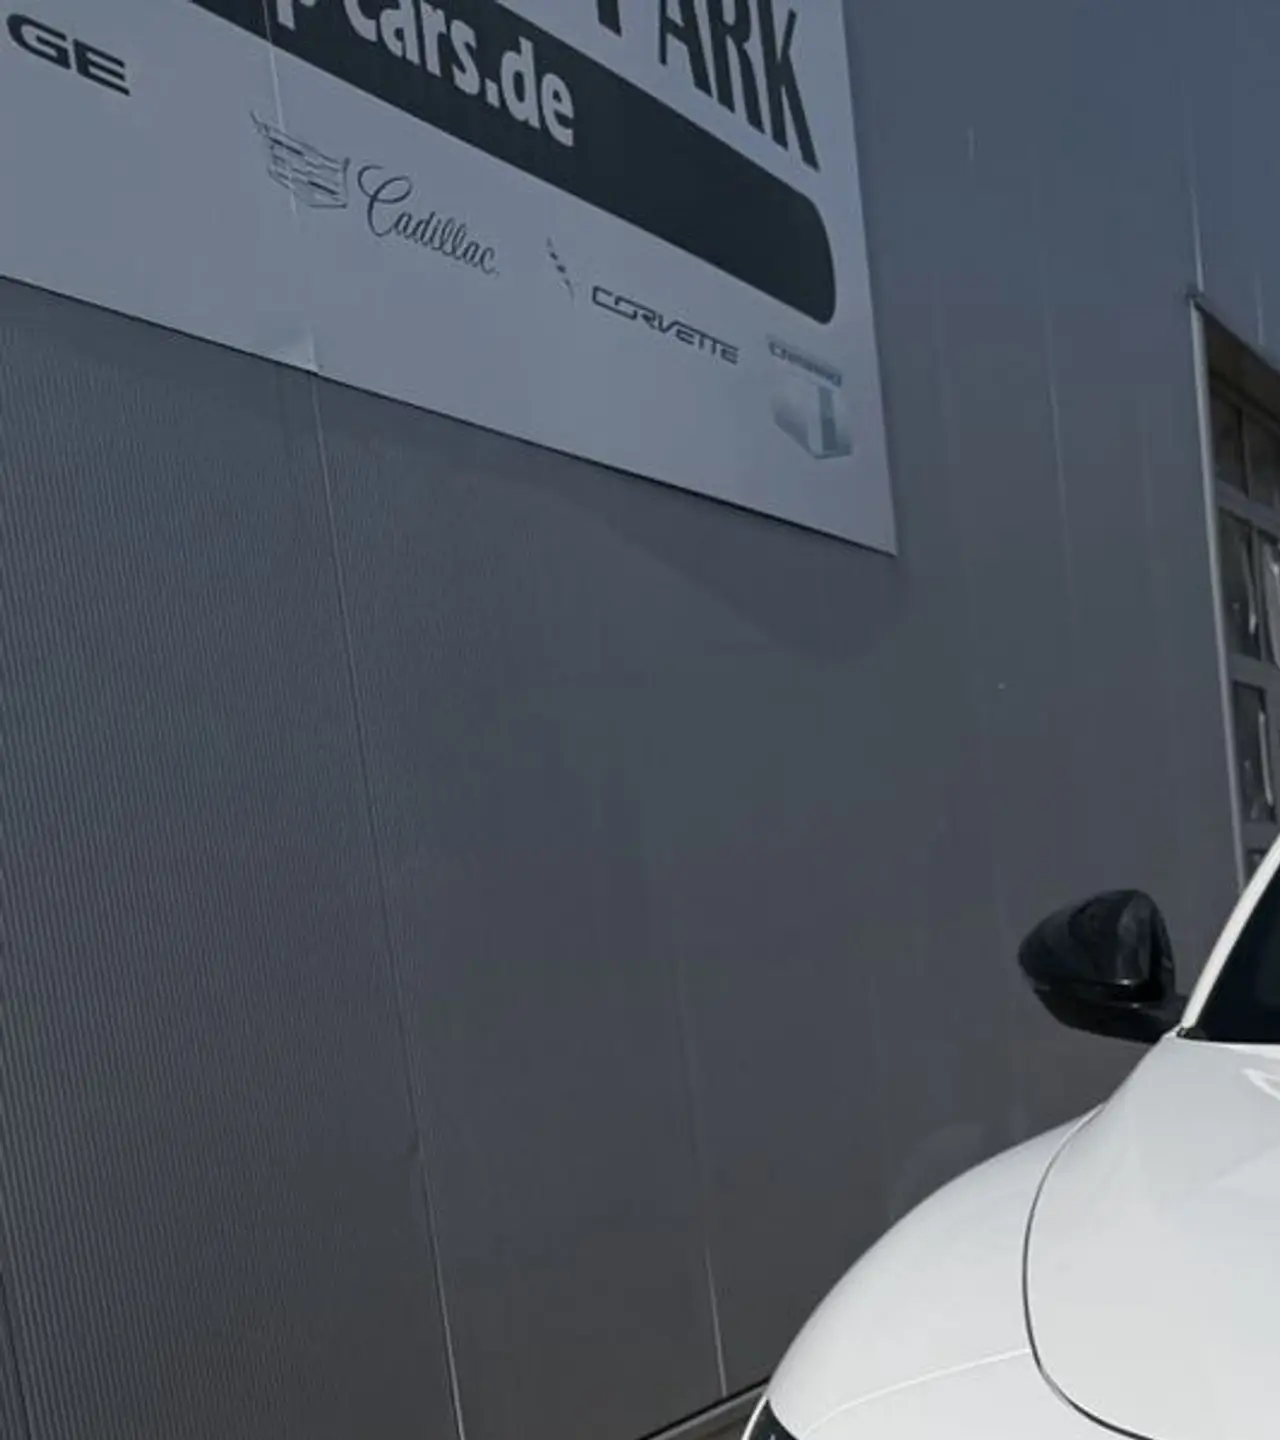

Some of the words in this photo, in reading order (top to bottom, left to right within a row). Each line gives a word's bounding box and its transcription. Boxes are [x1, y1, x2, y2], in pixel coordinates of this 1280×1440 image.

[596, 0, 820, 172] ARK
[357, 164, 499, 275] Cadillac
[592, 285, 740, 365] CORVETTE
